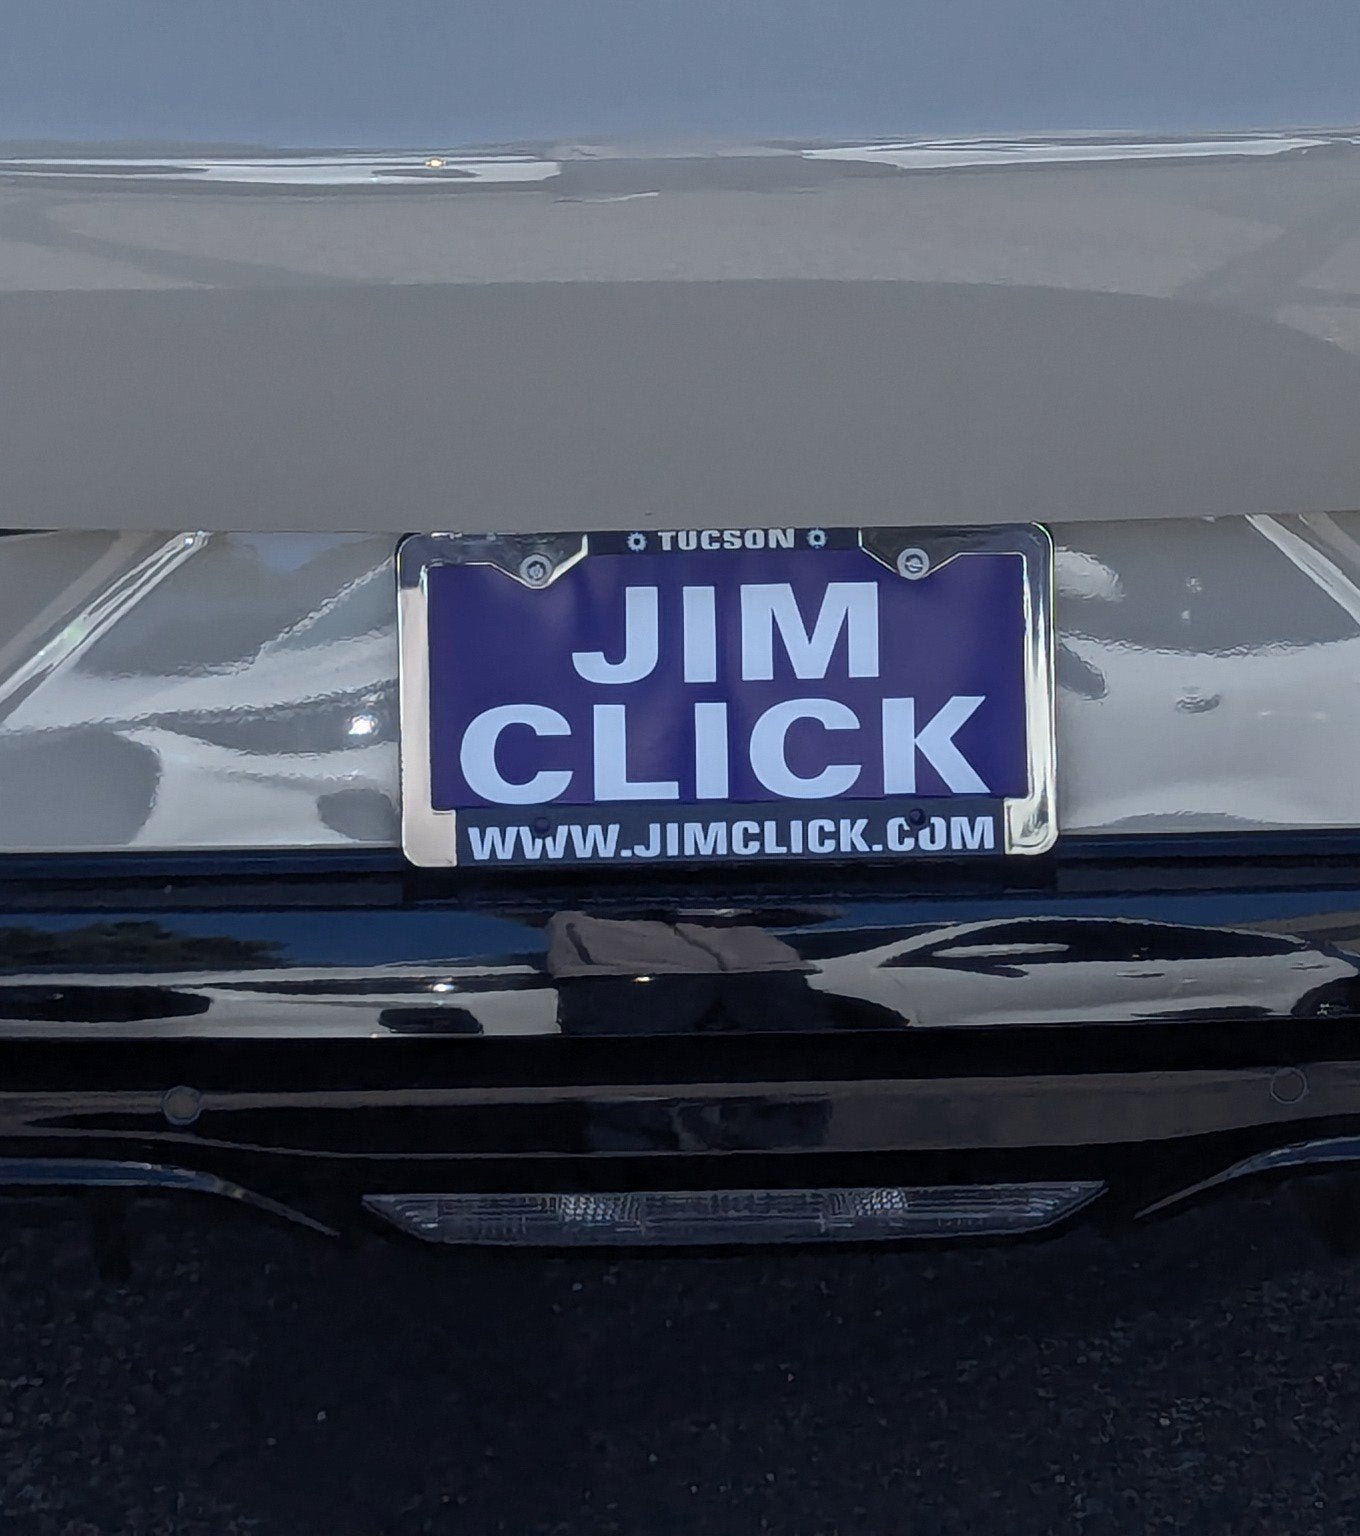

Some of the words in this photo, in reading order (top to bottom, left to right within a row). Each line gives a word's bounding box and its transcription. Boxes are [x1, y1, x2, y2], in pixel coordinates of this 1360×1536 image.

[658, 528, 796, 551] TUCSON
[571, 580, 881, 685] JIM
[459, 695, 993, 806] CLICK
[467, 816, 995, 860] WWW.JIMCLICK.COM
